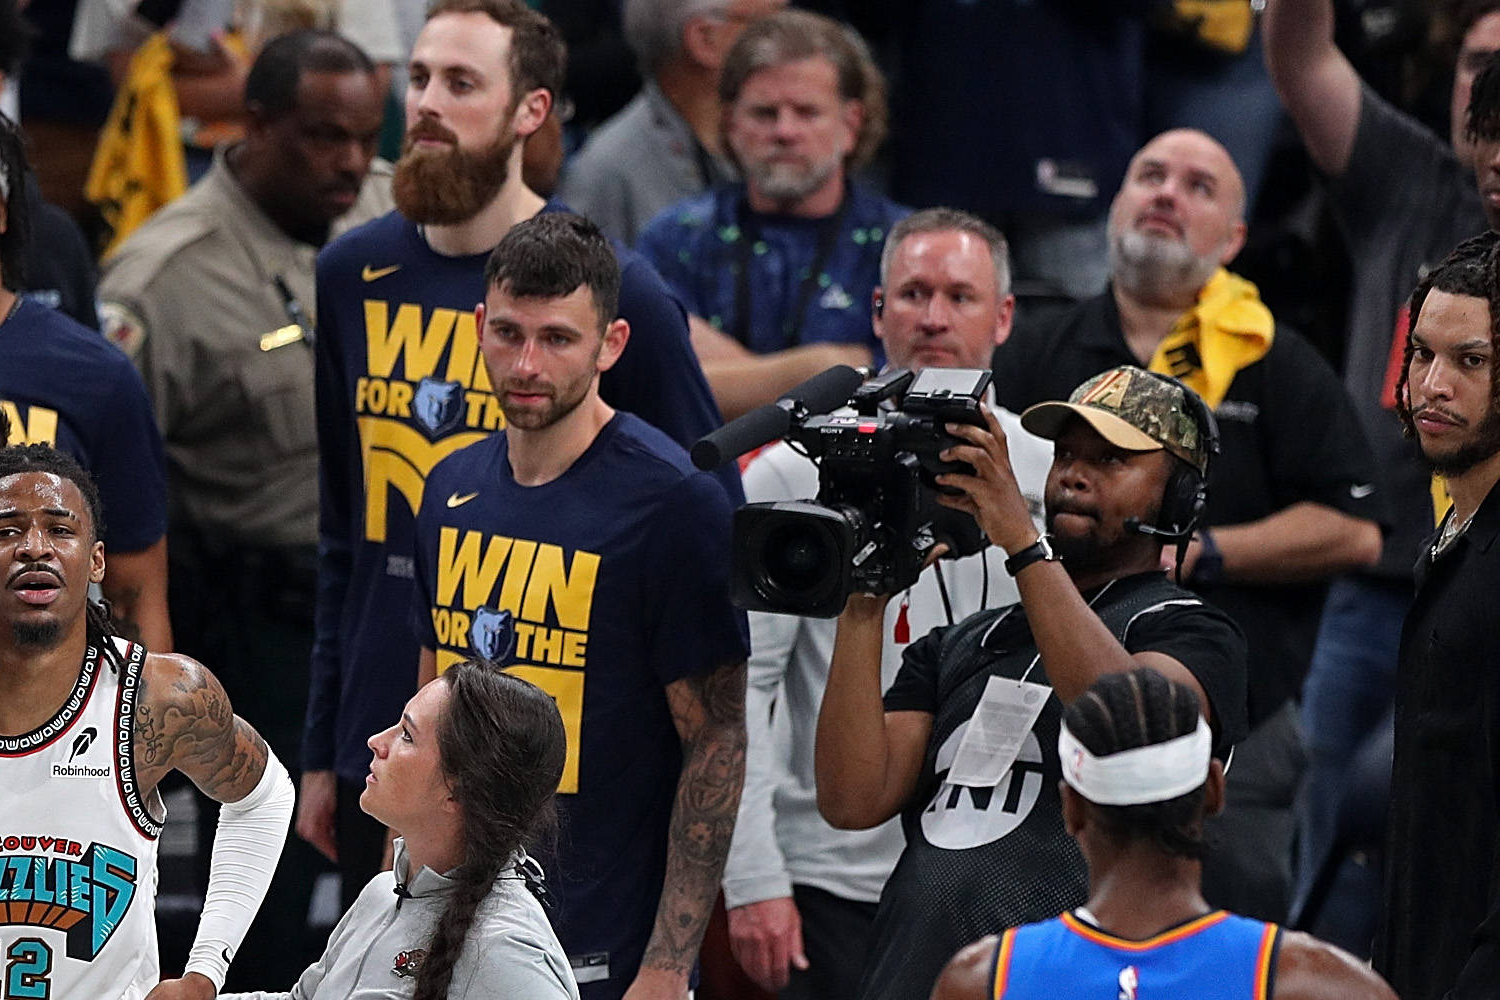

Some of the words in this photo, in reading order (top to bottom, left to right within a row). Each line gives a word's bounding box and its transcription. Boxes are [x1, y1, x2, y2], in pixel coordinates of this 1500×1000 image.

[356, 377, 414, 417] FOR
[436, 526, 601, 631] WIN
[515, 621, 588, 667] THE
[52, 764, 110, 777] Robinhood
